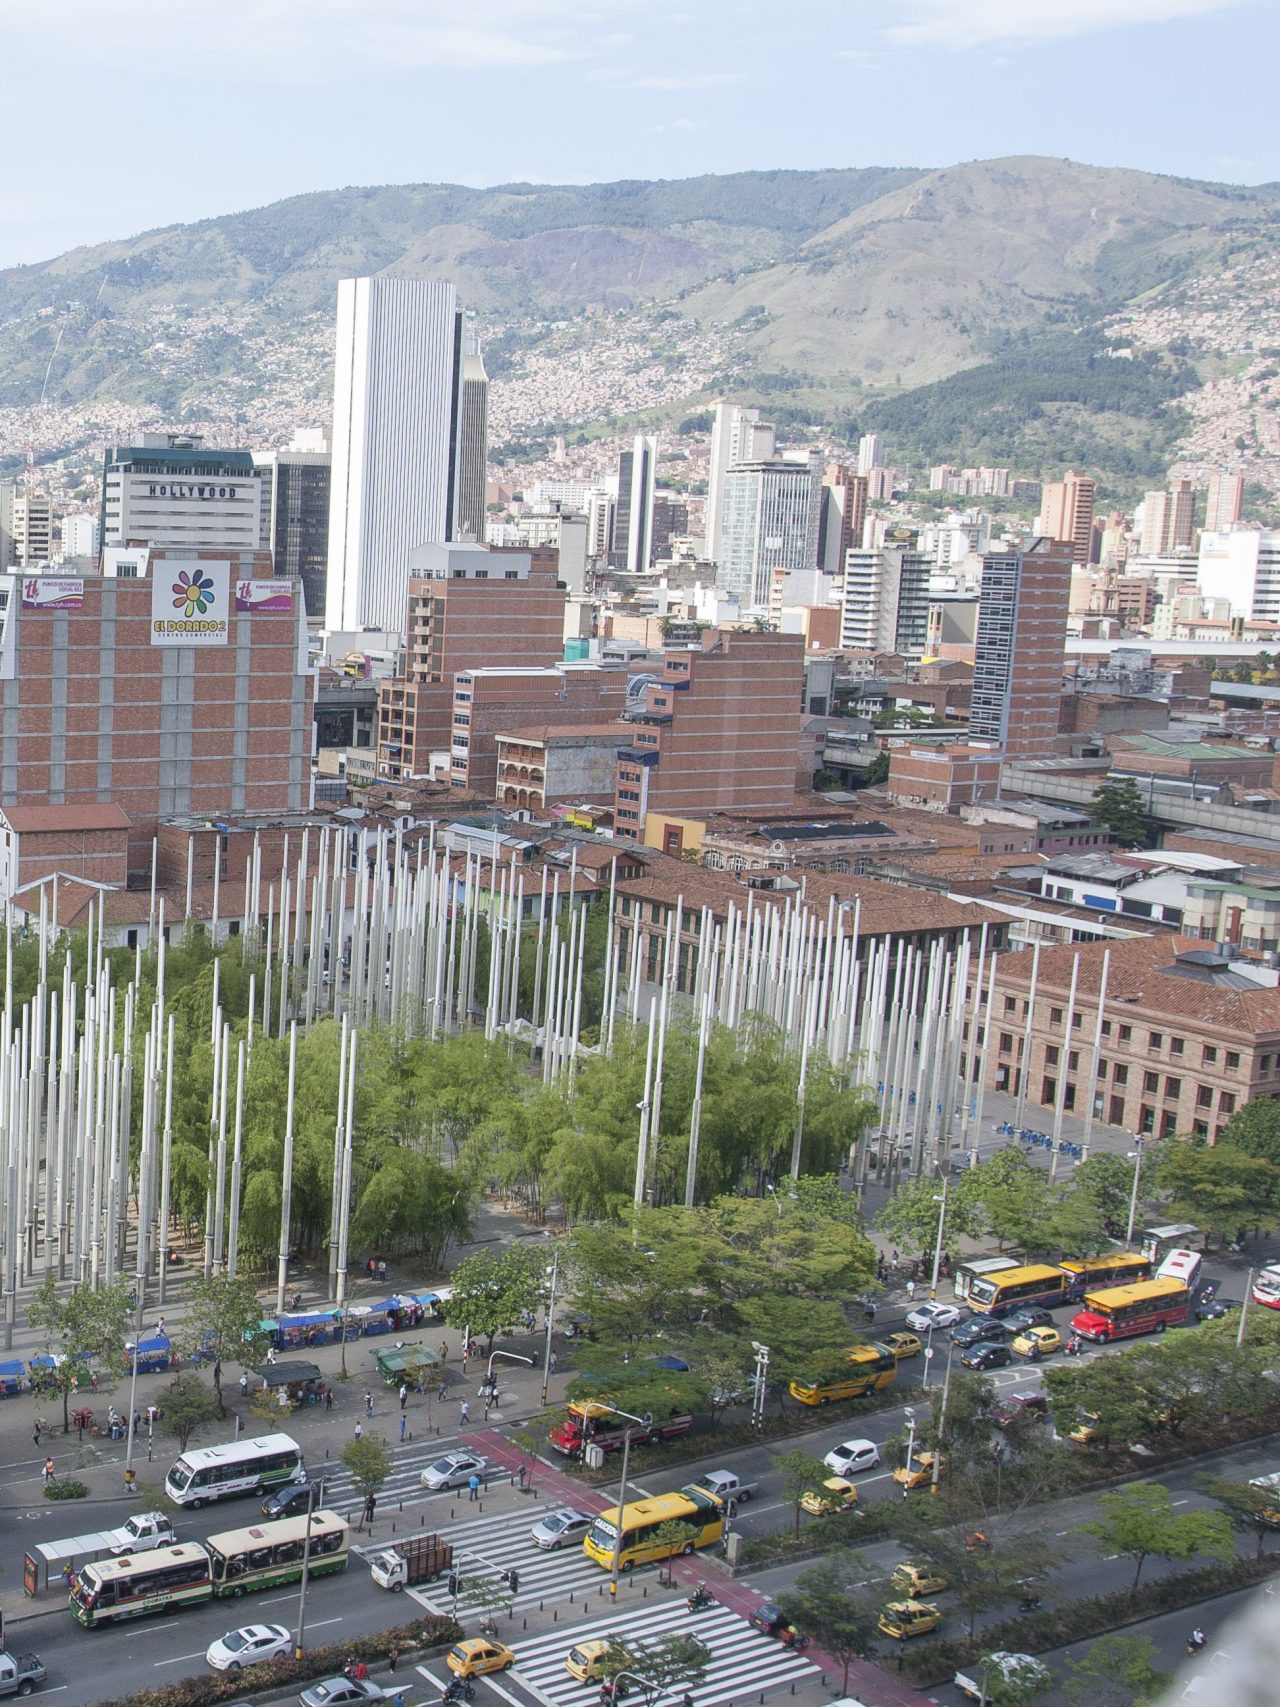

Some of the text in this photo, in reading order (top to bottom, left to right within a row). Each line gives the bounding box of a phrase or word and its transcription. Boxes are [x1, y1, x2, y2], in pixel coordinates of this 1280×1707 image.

[149, 485, 236, 498] HOLLYWOOD
[154, 620, 226, 632] EL DORADO 2
